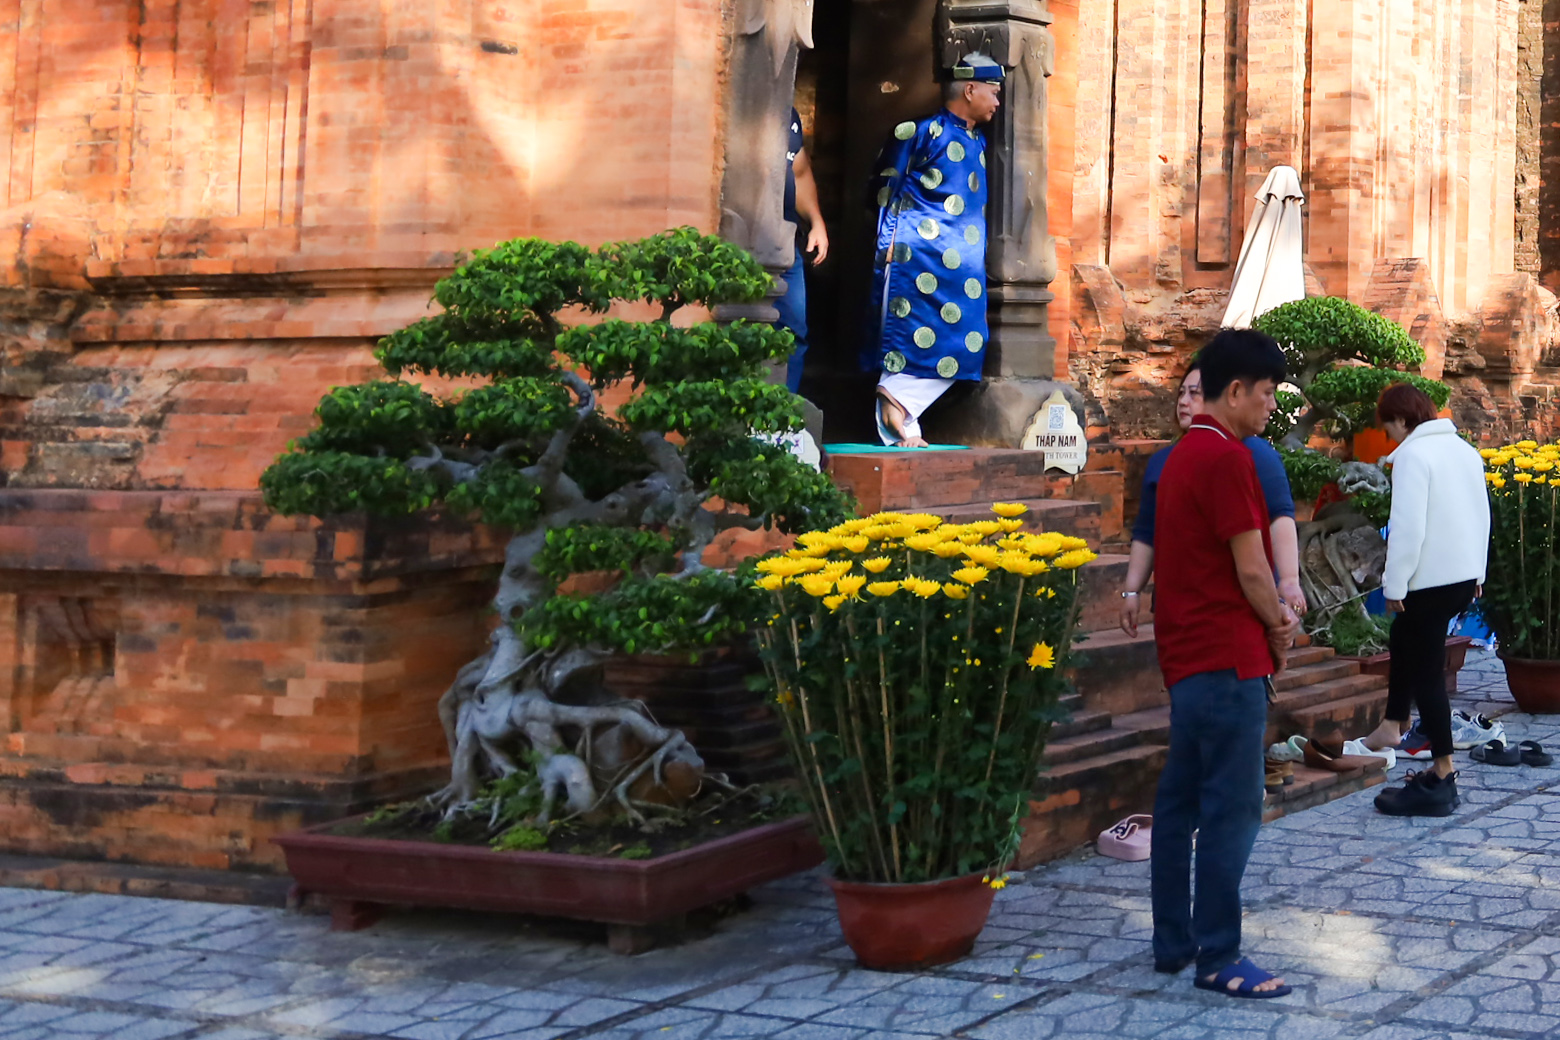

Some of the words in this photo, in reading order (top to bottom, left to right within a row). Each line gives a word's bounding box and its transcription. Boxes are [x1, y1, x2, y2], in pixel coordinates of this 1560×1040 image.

[1036, 433, 1056, 447] THÁP
[1058, 435, 1077, 447] NAM
[1055, 451, 1078, 460] TOWER
